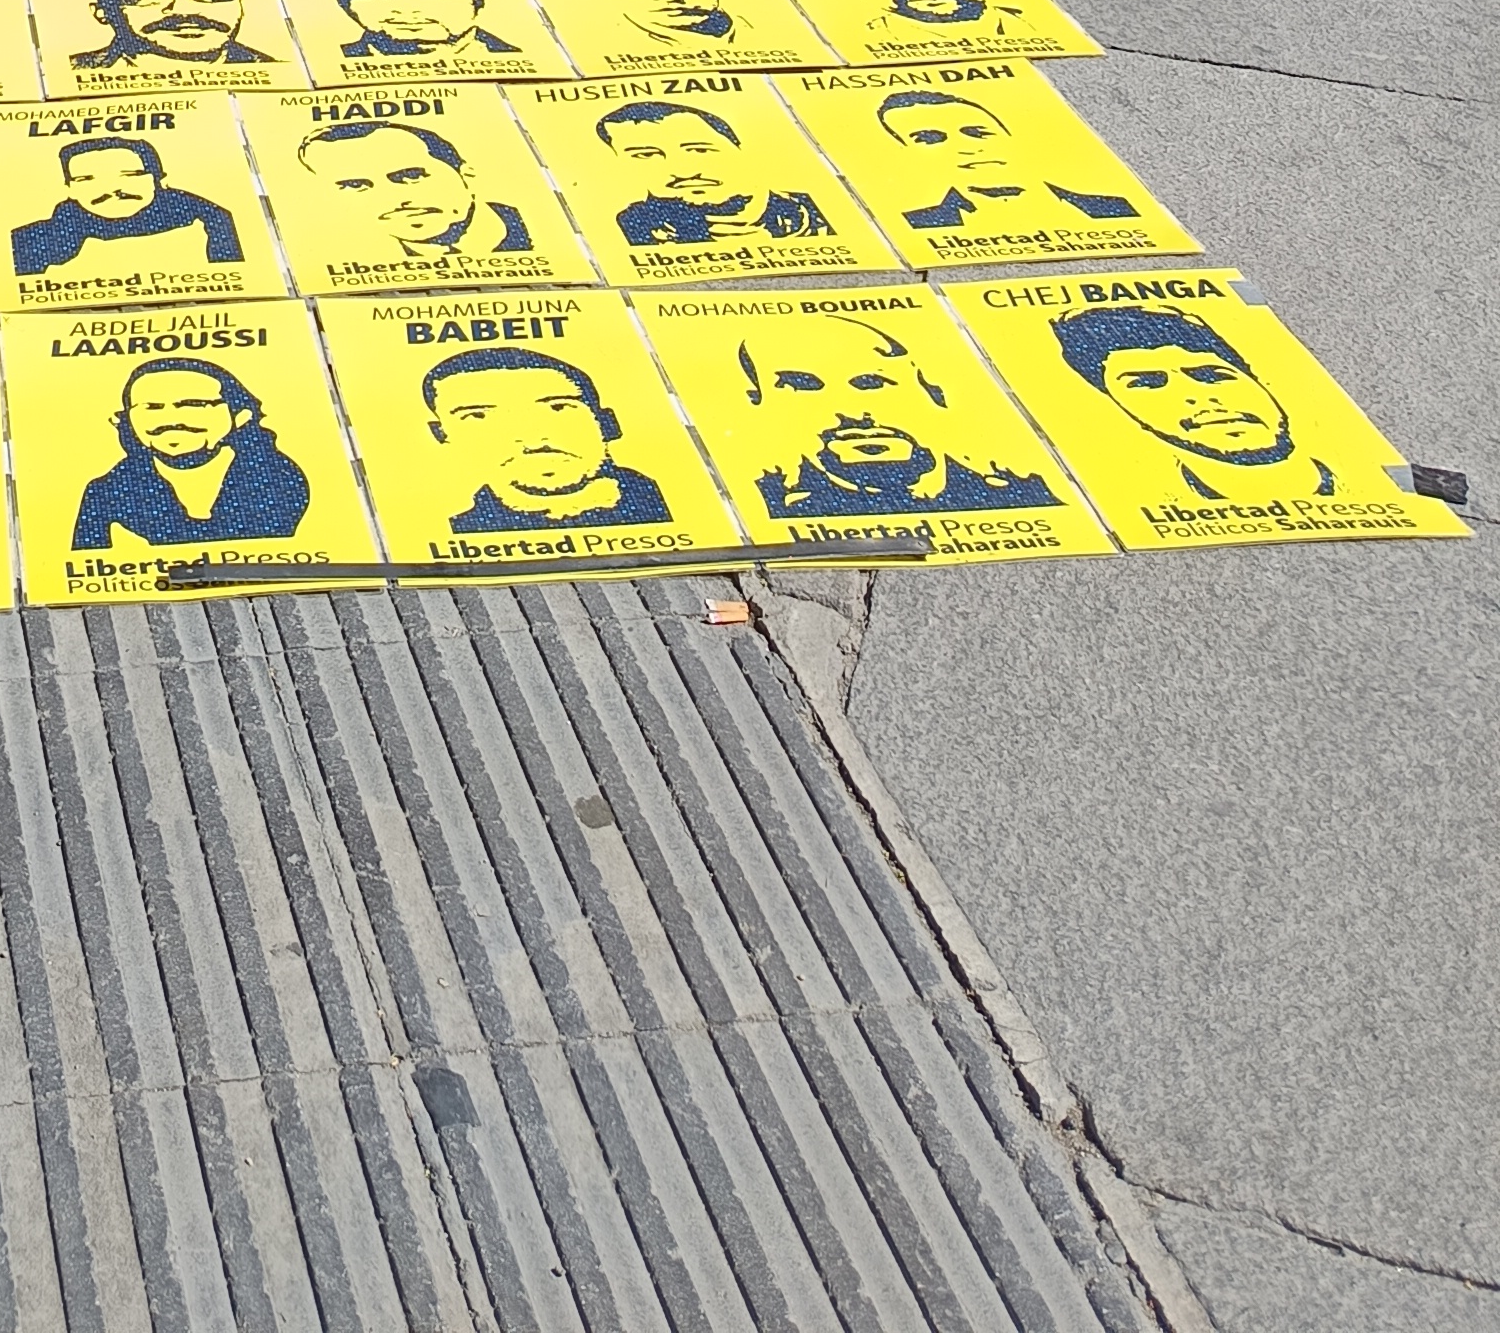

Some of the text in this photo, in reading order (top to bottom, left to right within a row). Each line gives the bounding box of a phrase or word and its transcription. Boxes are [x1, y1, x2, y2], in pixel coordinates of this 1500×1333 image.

[536, 76, 742, 102] HUSEIN ZAUI
[801, 64, 1015, 92] HASSAN DAH
[106, 98, 197, 116] EMBAREK
[280, 86, 458, 108] MOHAMED LAMIN
[311, 97, 444, 122] HADDI
[28, 112, 175, 137] LAFGIR
[658, 295, 923, 319] MOHAMED BOURIAL
[983, 277, 1227, 311] CHEJ BANGA
[372, 298, 582, 322] MOHAMED JUNA
[70, 312, 236, 338] ABDEL JALIL
[406, 315, 569, 345] BABEIT
[51, 327, 268, 357] LAAROUSSI
[1142, 497, 1405, 527] Libertad Presos
[1153, 510, 1417, 540] Políticos Saharauis
